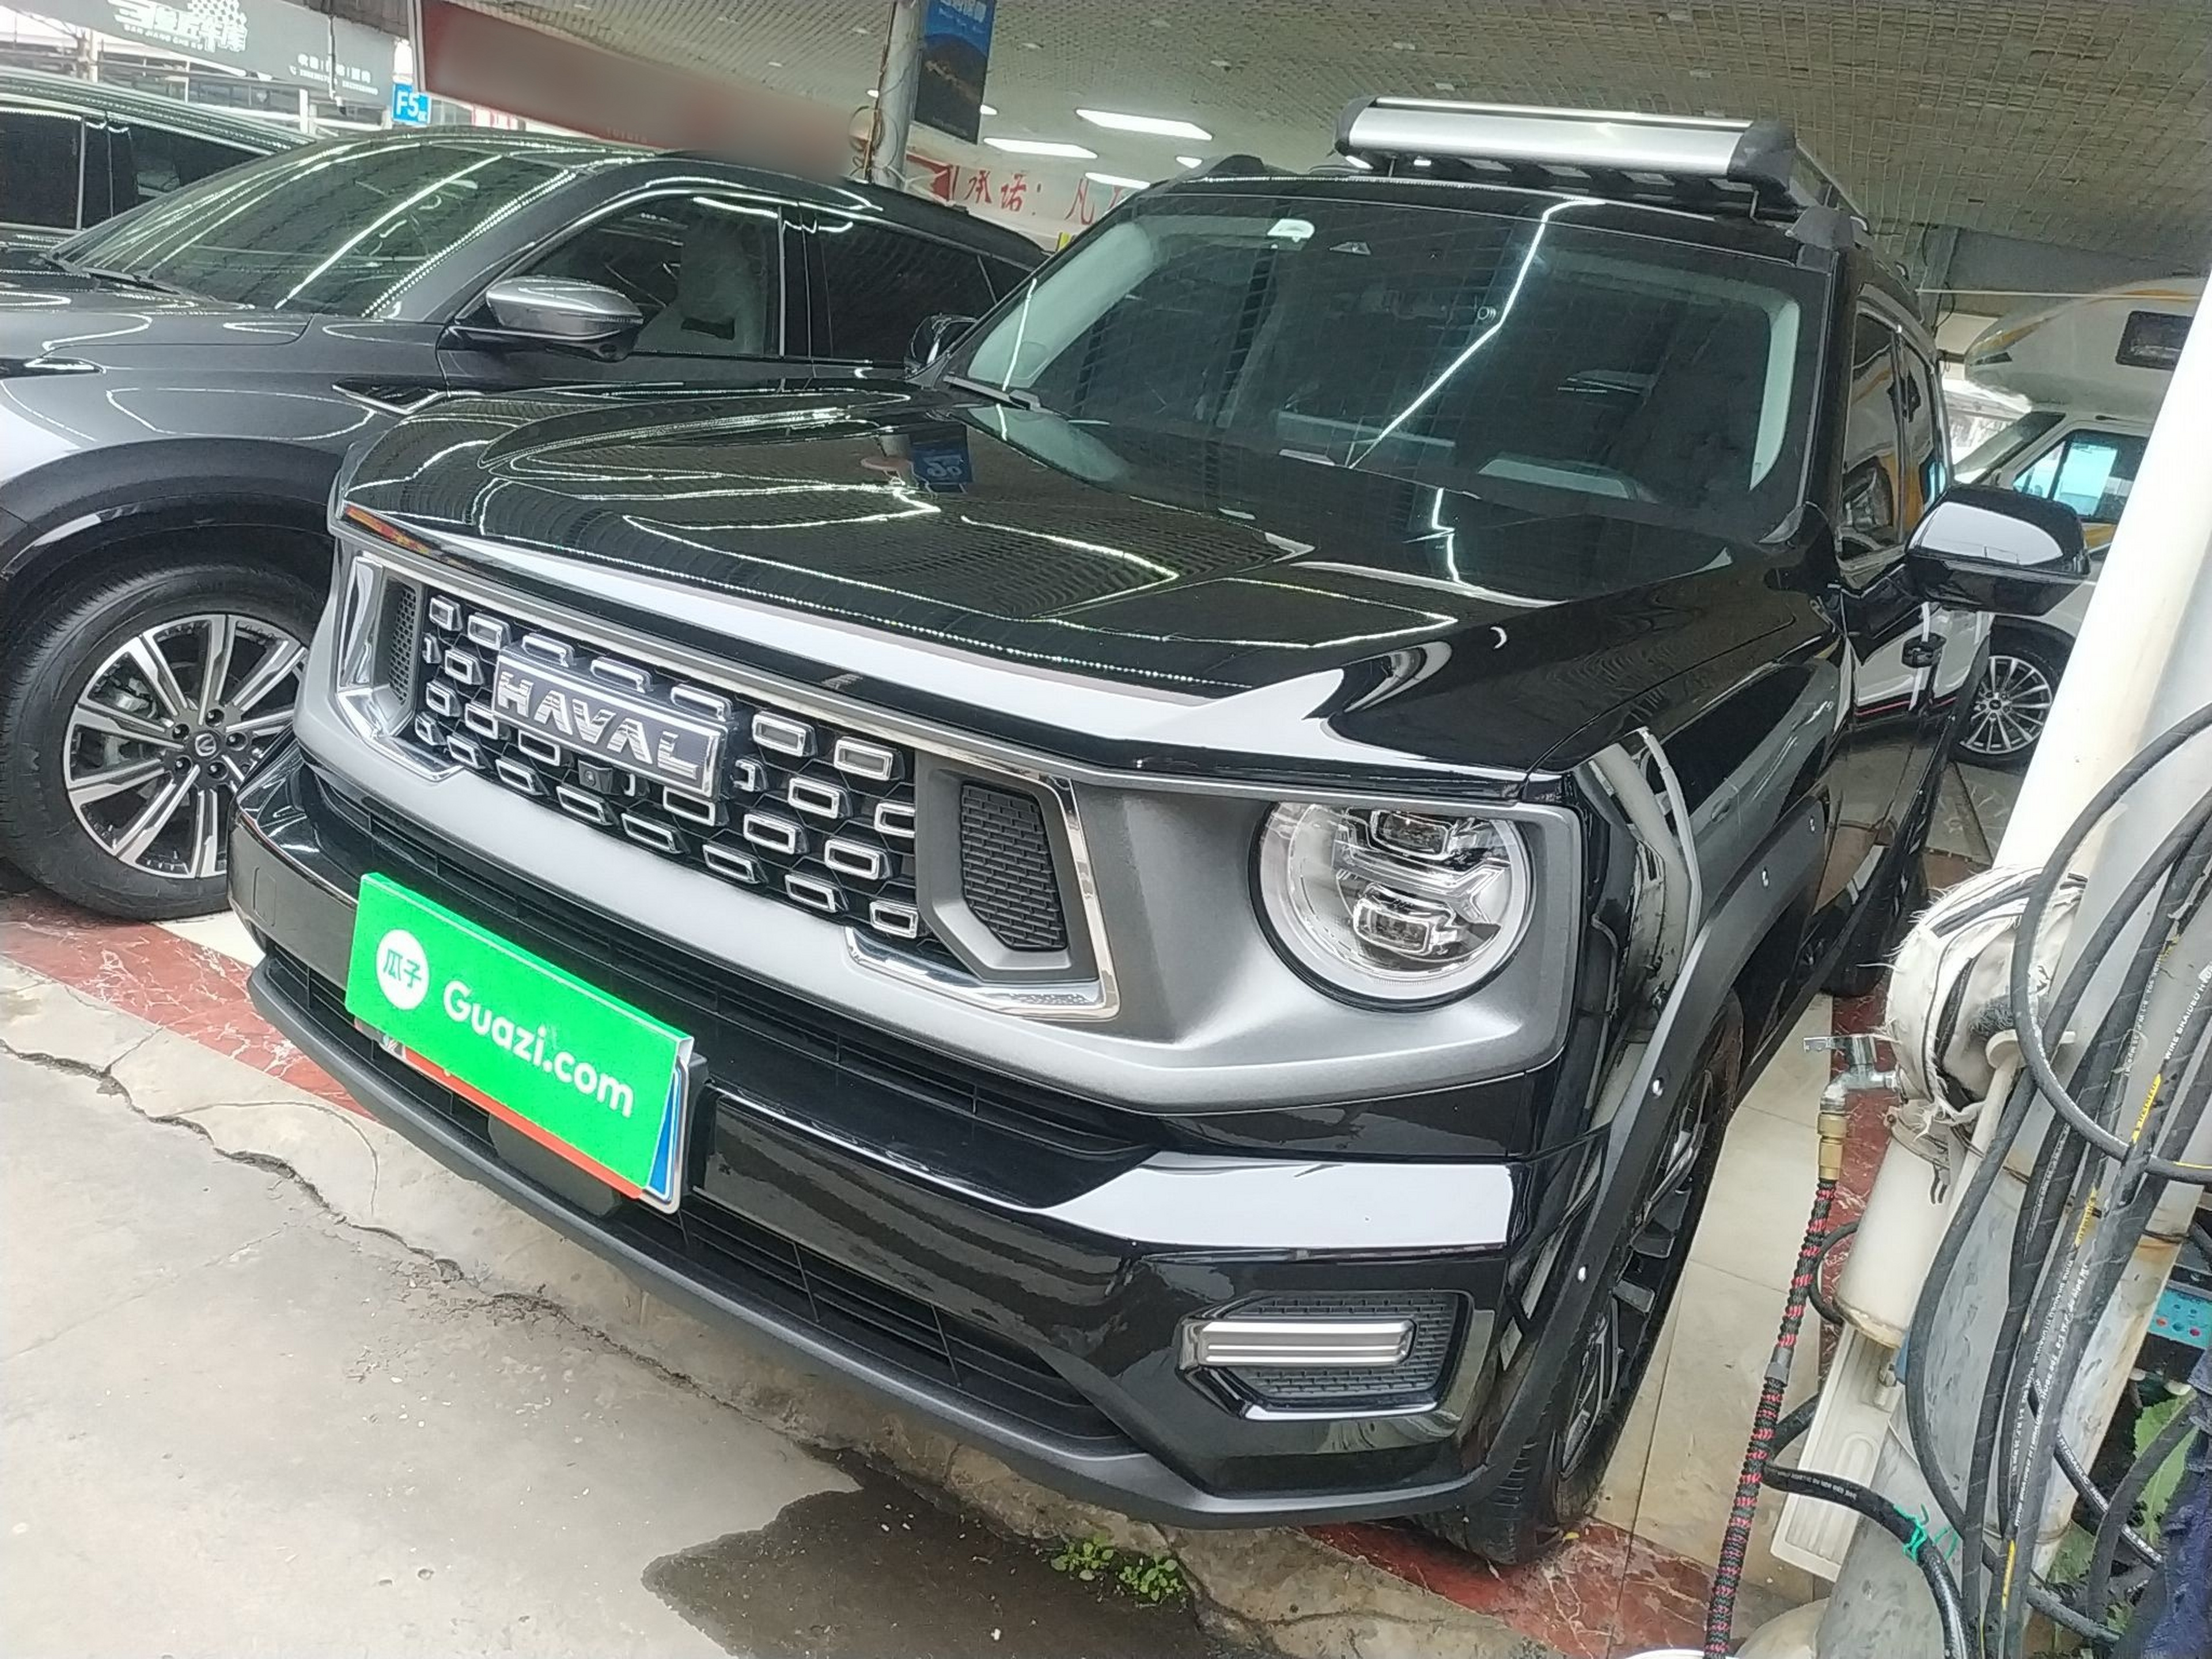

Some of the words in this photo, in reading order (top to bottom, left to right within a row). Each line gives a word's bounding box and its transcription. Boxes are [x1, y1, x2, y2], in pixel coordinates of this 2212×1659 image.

[497, 671, 699, 779] HAVAL
[383, 948, 422, 989] 瓜子
[442, 980, 634, 1118] Guazi.com
[2164, 1036, 2179, 1060] WIRE
[2176, 992, 2200, 1035] BRAIDED
[2059, 1438, 2090, 1486] HYDRAULIC
[2091, 1487, 2109, 1510] HOSE
